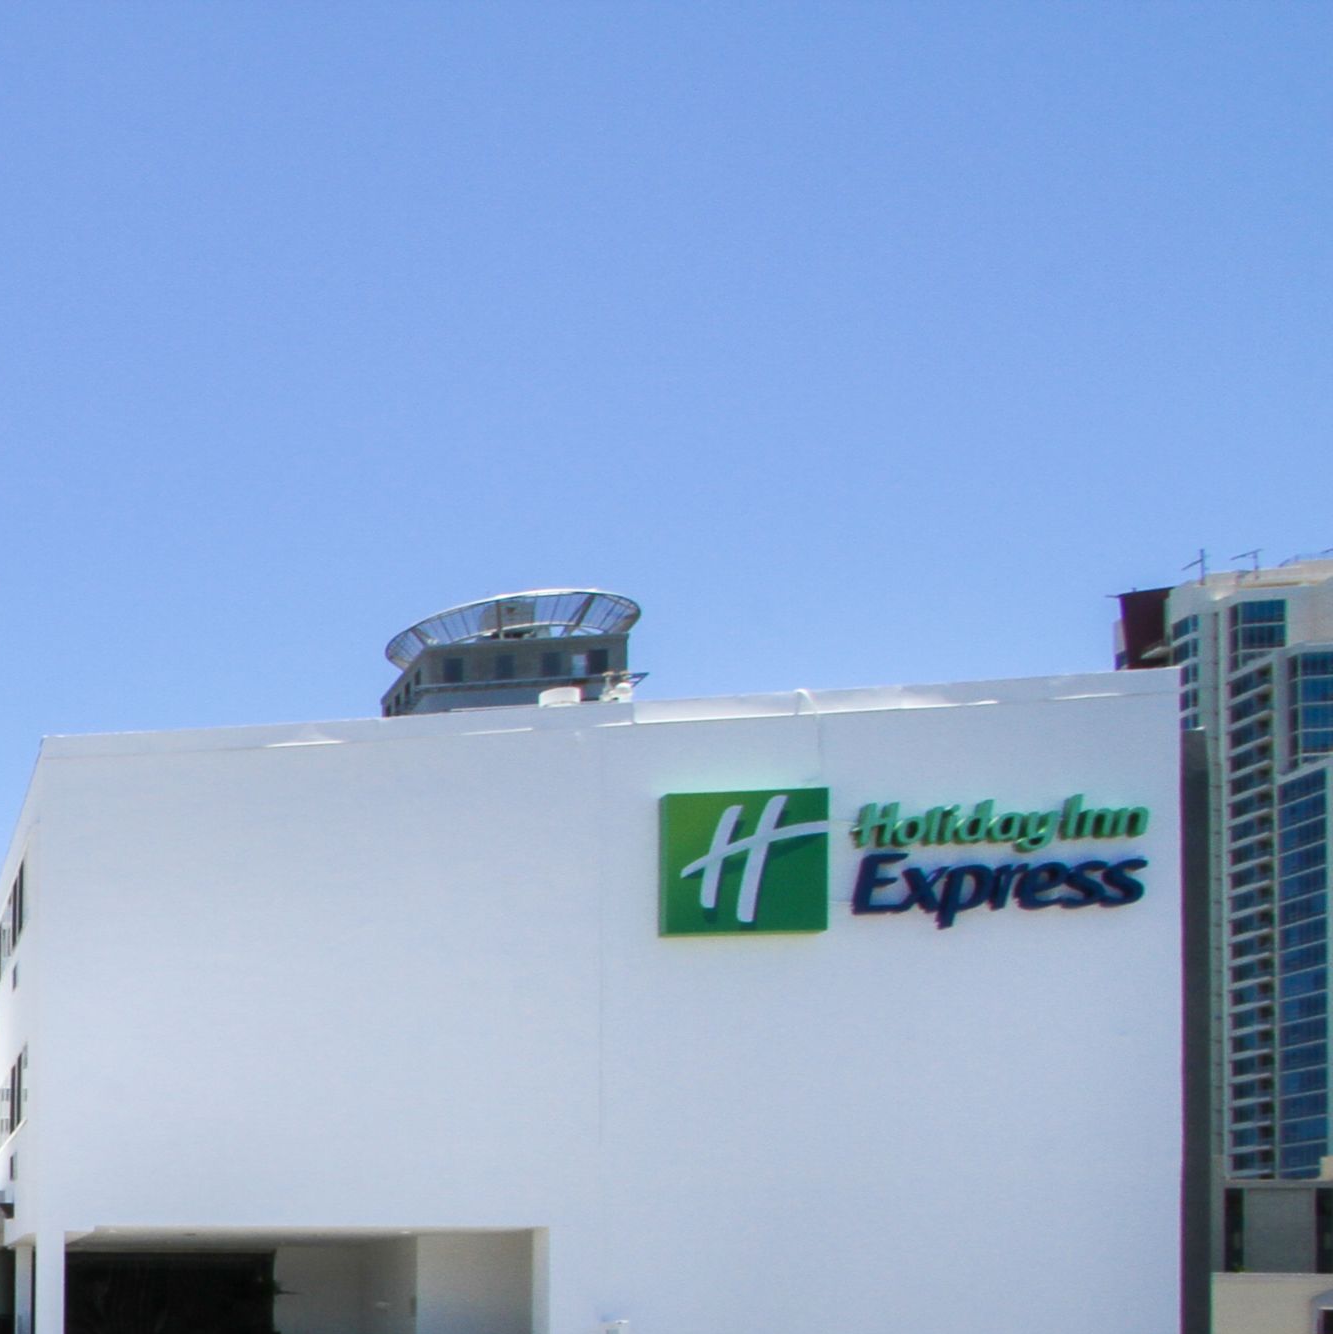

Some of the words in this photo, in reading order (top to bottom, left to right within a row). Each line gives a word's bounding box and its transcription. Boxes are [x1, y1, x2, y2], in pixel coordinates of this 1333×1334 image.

[850, 799, 1061, 853] Holiday
[1060, 793, 1150, 841] Inn
[851, 852, 1149, 930] Express
